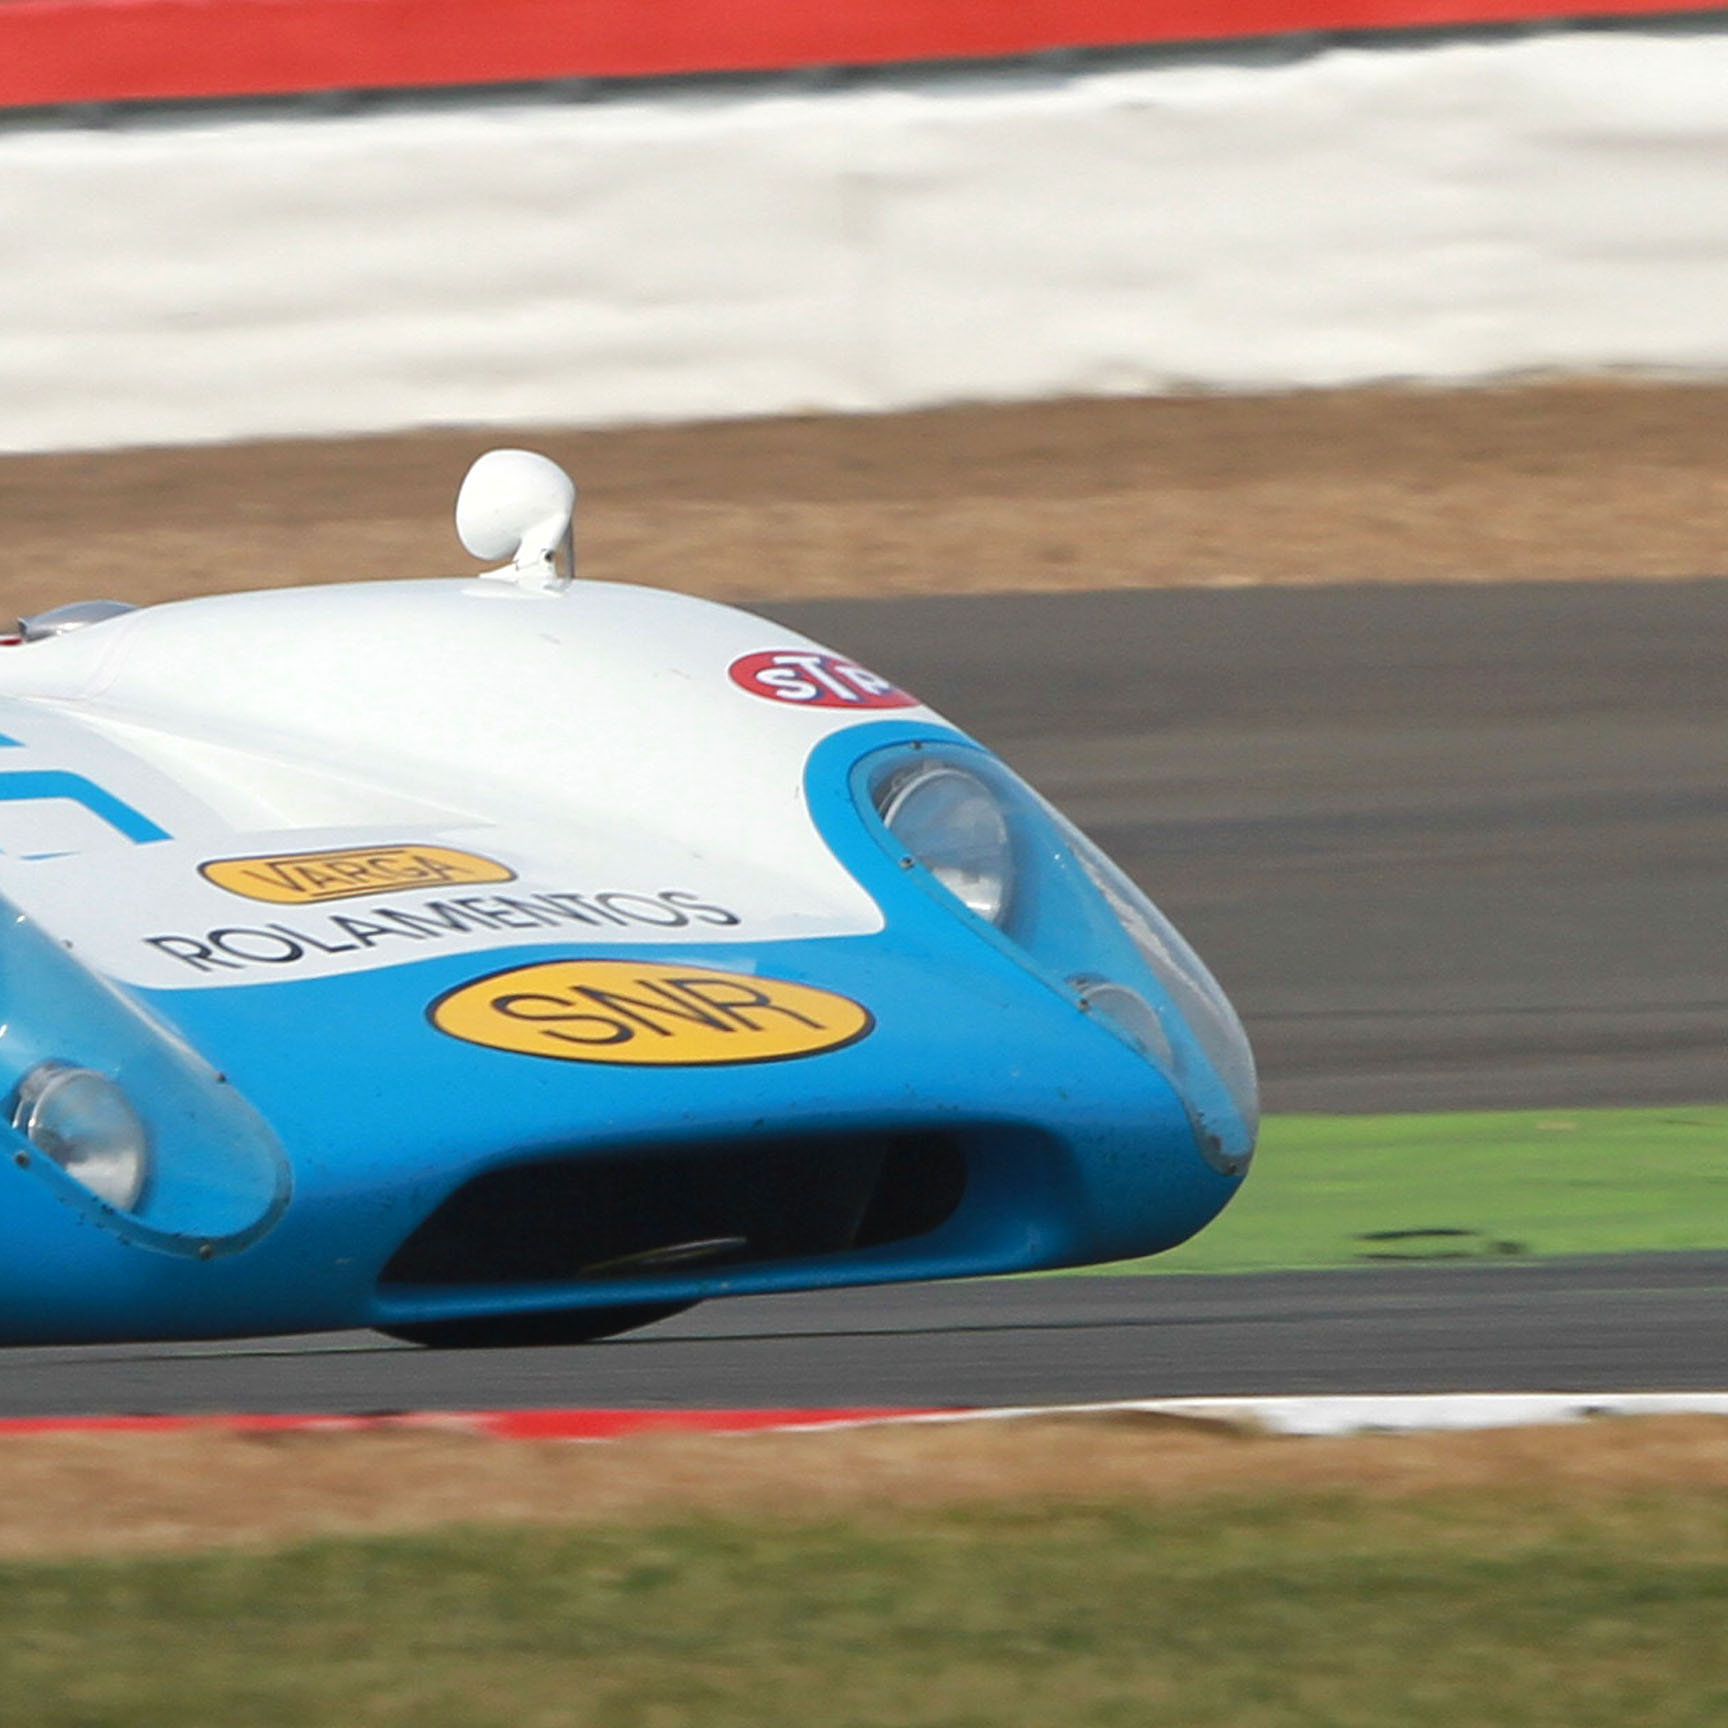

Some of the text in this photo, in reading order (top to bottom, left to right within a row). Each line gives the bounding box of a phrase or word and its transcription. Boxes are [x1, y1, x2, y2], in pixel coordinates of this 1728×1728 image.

[755, 655, 891, 702] STP
[240, 849, 474, 898] VARGA
[145, 891, 742, 972] ROLAMENTOS
[492, 977, 825, 1046] SNR
